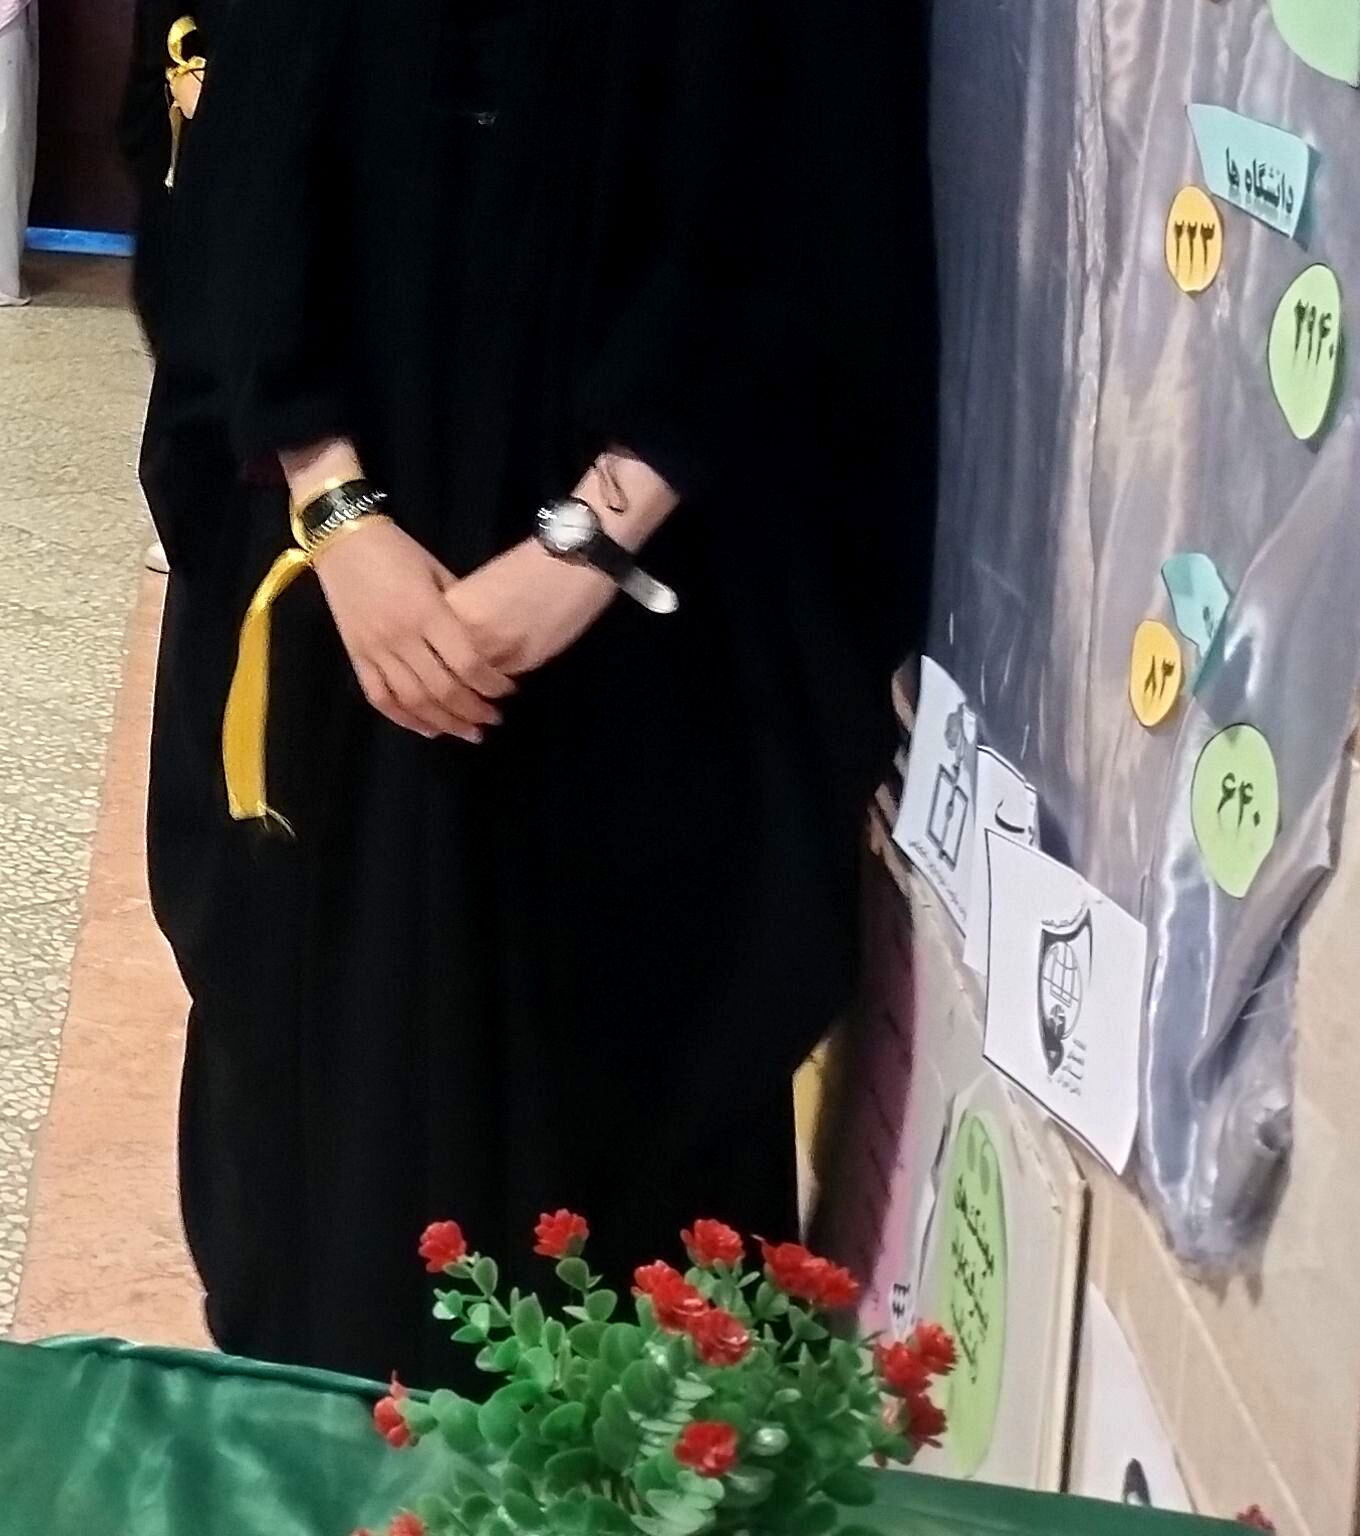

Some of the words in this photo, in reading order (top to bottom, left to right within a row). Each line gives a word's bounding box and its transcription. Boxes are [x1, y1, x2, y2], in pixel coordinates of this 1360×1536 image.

[1226, 146, 1241, 188] ها
[1244, 157, 1294, 215] دانشگاه
[1173, 220, 1216, 270] ۲۲۳
